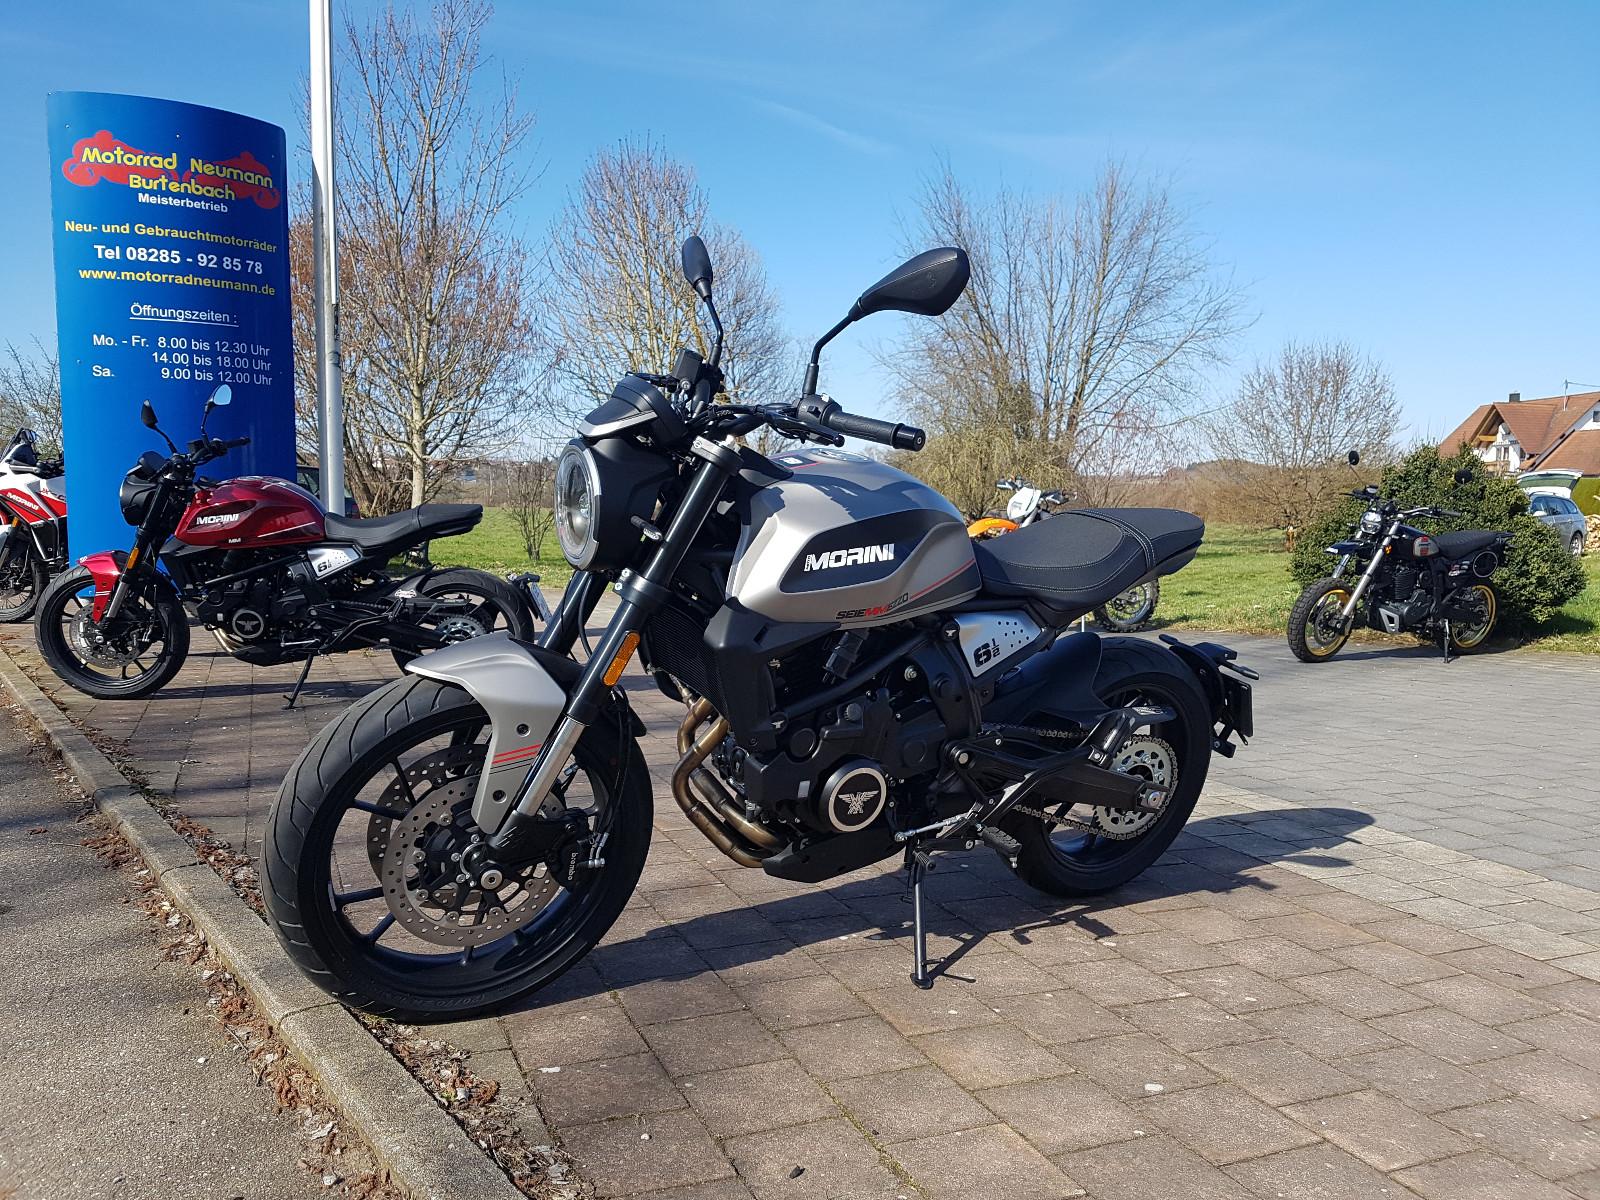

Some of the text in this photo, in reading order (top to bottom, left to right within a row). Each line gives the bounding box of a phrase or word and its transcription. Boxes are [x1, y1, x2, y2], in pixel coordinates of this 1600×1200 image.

[81, 146, 273, 189] Motorrad Neumann
[128, 174, 235, 201] Burtenbach
[137, 192, 228, 213] Meisterbetrieb
[64, 220, 277, 253] Neu- und Gebrauchtmotorräder
[93, 244, 121, 260] Tel
[125, 246, 181, 264] 08285
[197, 253, 218, 268] 92
[222, 256, 242, 271] 85
[245, 260, 263, 275] 78
[78, 269, 276, 296] www.motorradneumann.de
[130, 301, 230, 323] Öffnungszeiten
[92, 334, 118, 346] Mo.
[131, 335, 149, 347] Fr.
[157, 336, 188, 350] 8.00
[191, 338, 210, 351] bis
[214, 340, 248, 354] 12.30
[250, 343, 271, 357] Uhr
[152, 351, 272, 371] 14.00 bis 18.00 Uhr
[91, 364, 273, 386] Sa. 9.00 bis 12.00 Uhr
[196, 513, 240, 525] MORINI
[811, 543, 895, 572] MORINI
[567, 852, 579, 881] brembo
